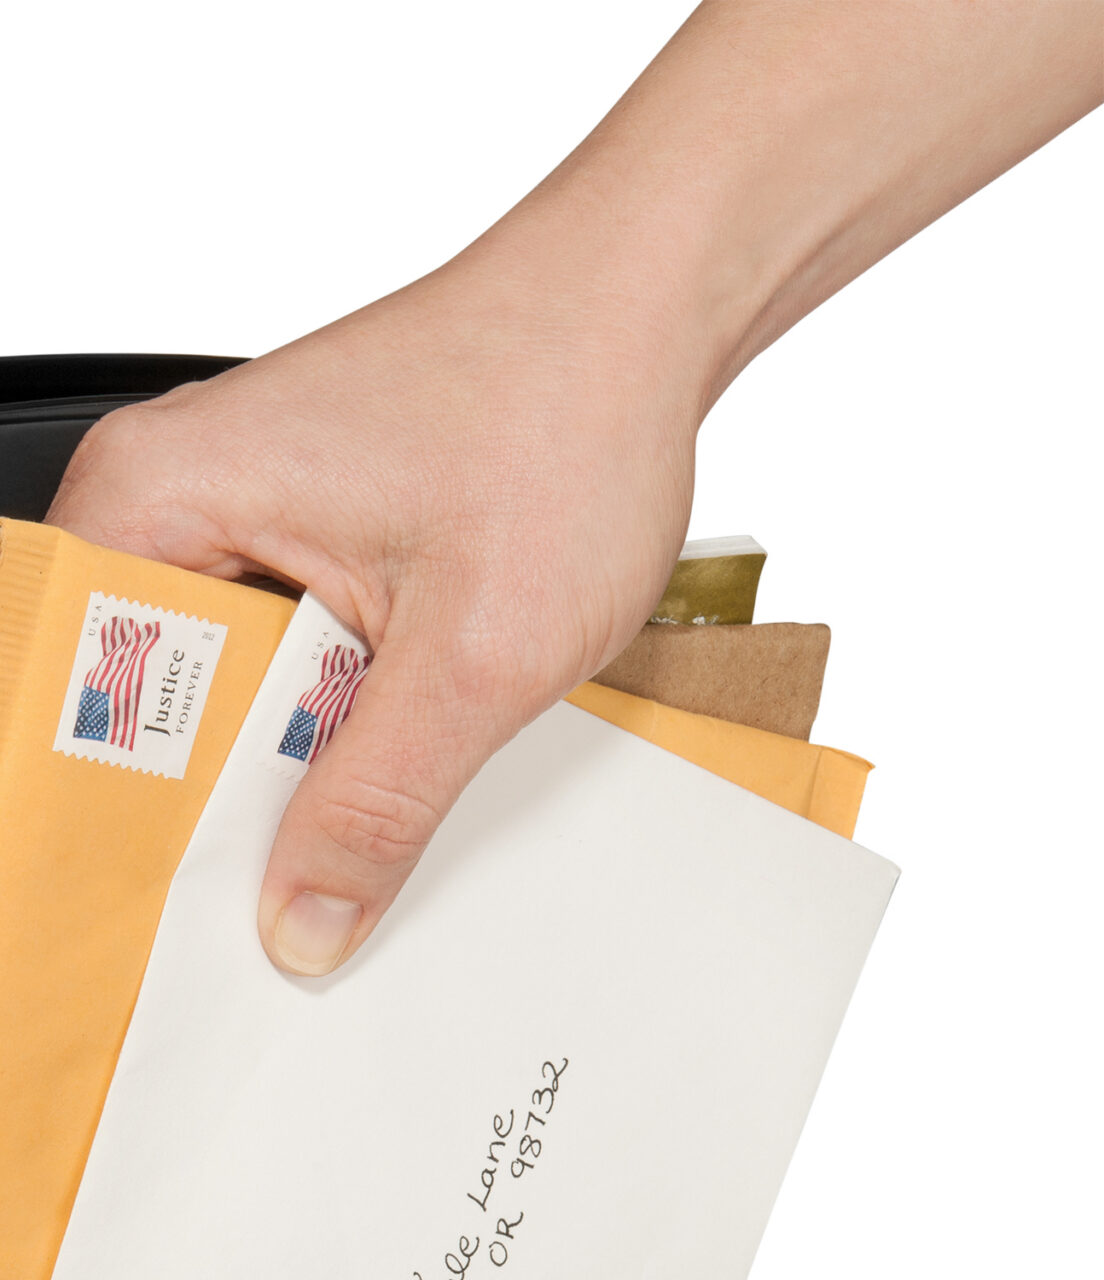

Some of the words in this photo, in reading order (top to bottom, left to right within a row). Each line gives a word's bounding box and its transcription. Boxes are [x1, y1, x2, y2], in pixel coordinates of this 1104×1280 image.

[144, 649, 185, 736] Justice
[176, 661, 203, 734] FOREVER
[468, 1110, 513, 1211] Lane
[490, 1212, 523, 1266] OR
[511, 1059, 568, 1178] 98732
